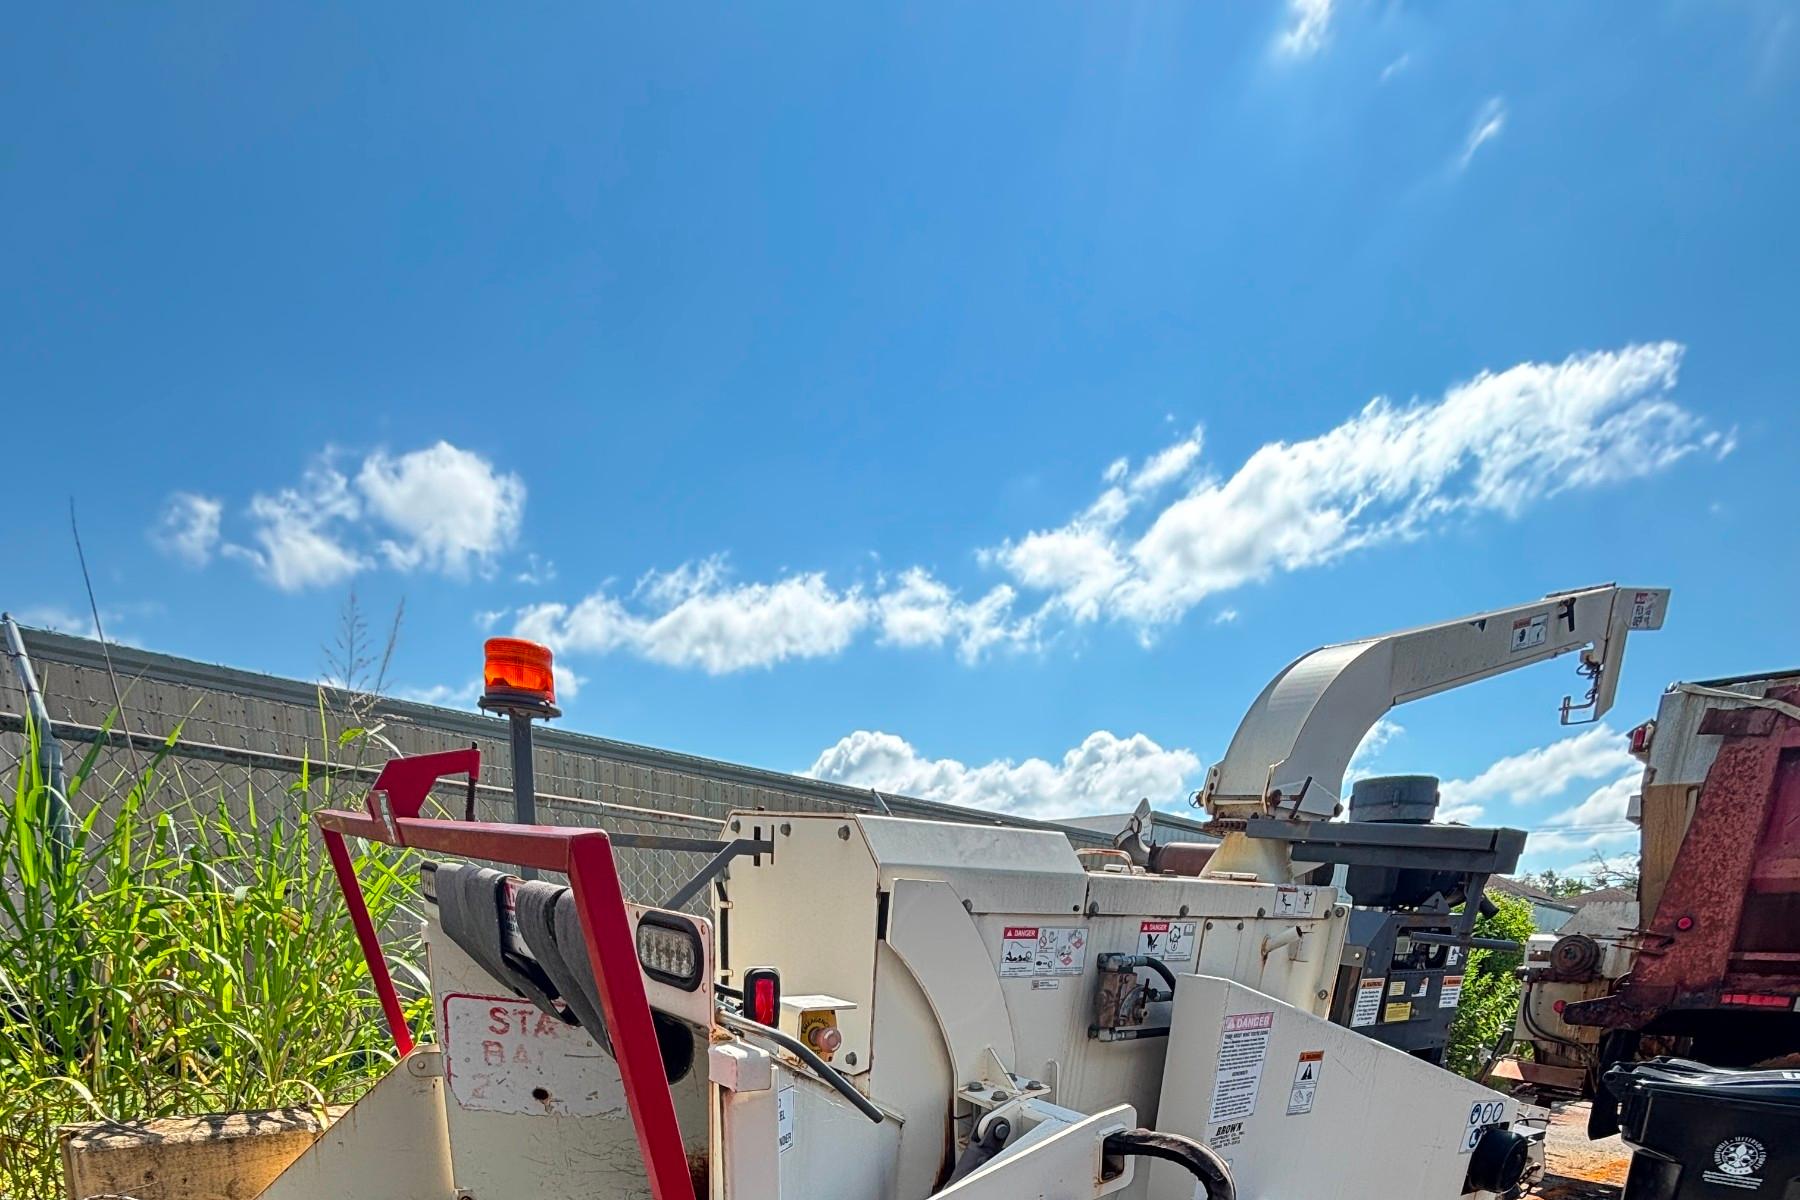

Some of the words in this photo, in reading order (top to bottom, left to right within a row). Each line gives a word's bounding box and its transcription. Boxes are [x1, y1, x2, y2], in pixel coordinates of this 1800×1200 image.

[1014, 929, 1036, 937] DANGER
[1236, 1016, 1270, 1028] DANGER
[1216, 1122, 1243, 1136] BROWN
